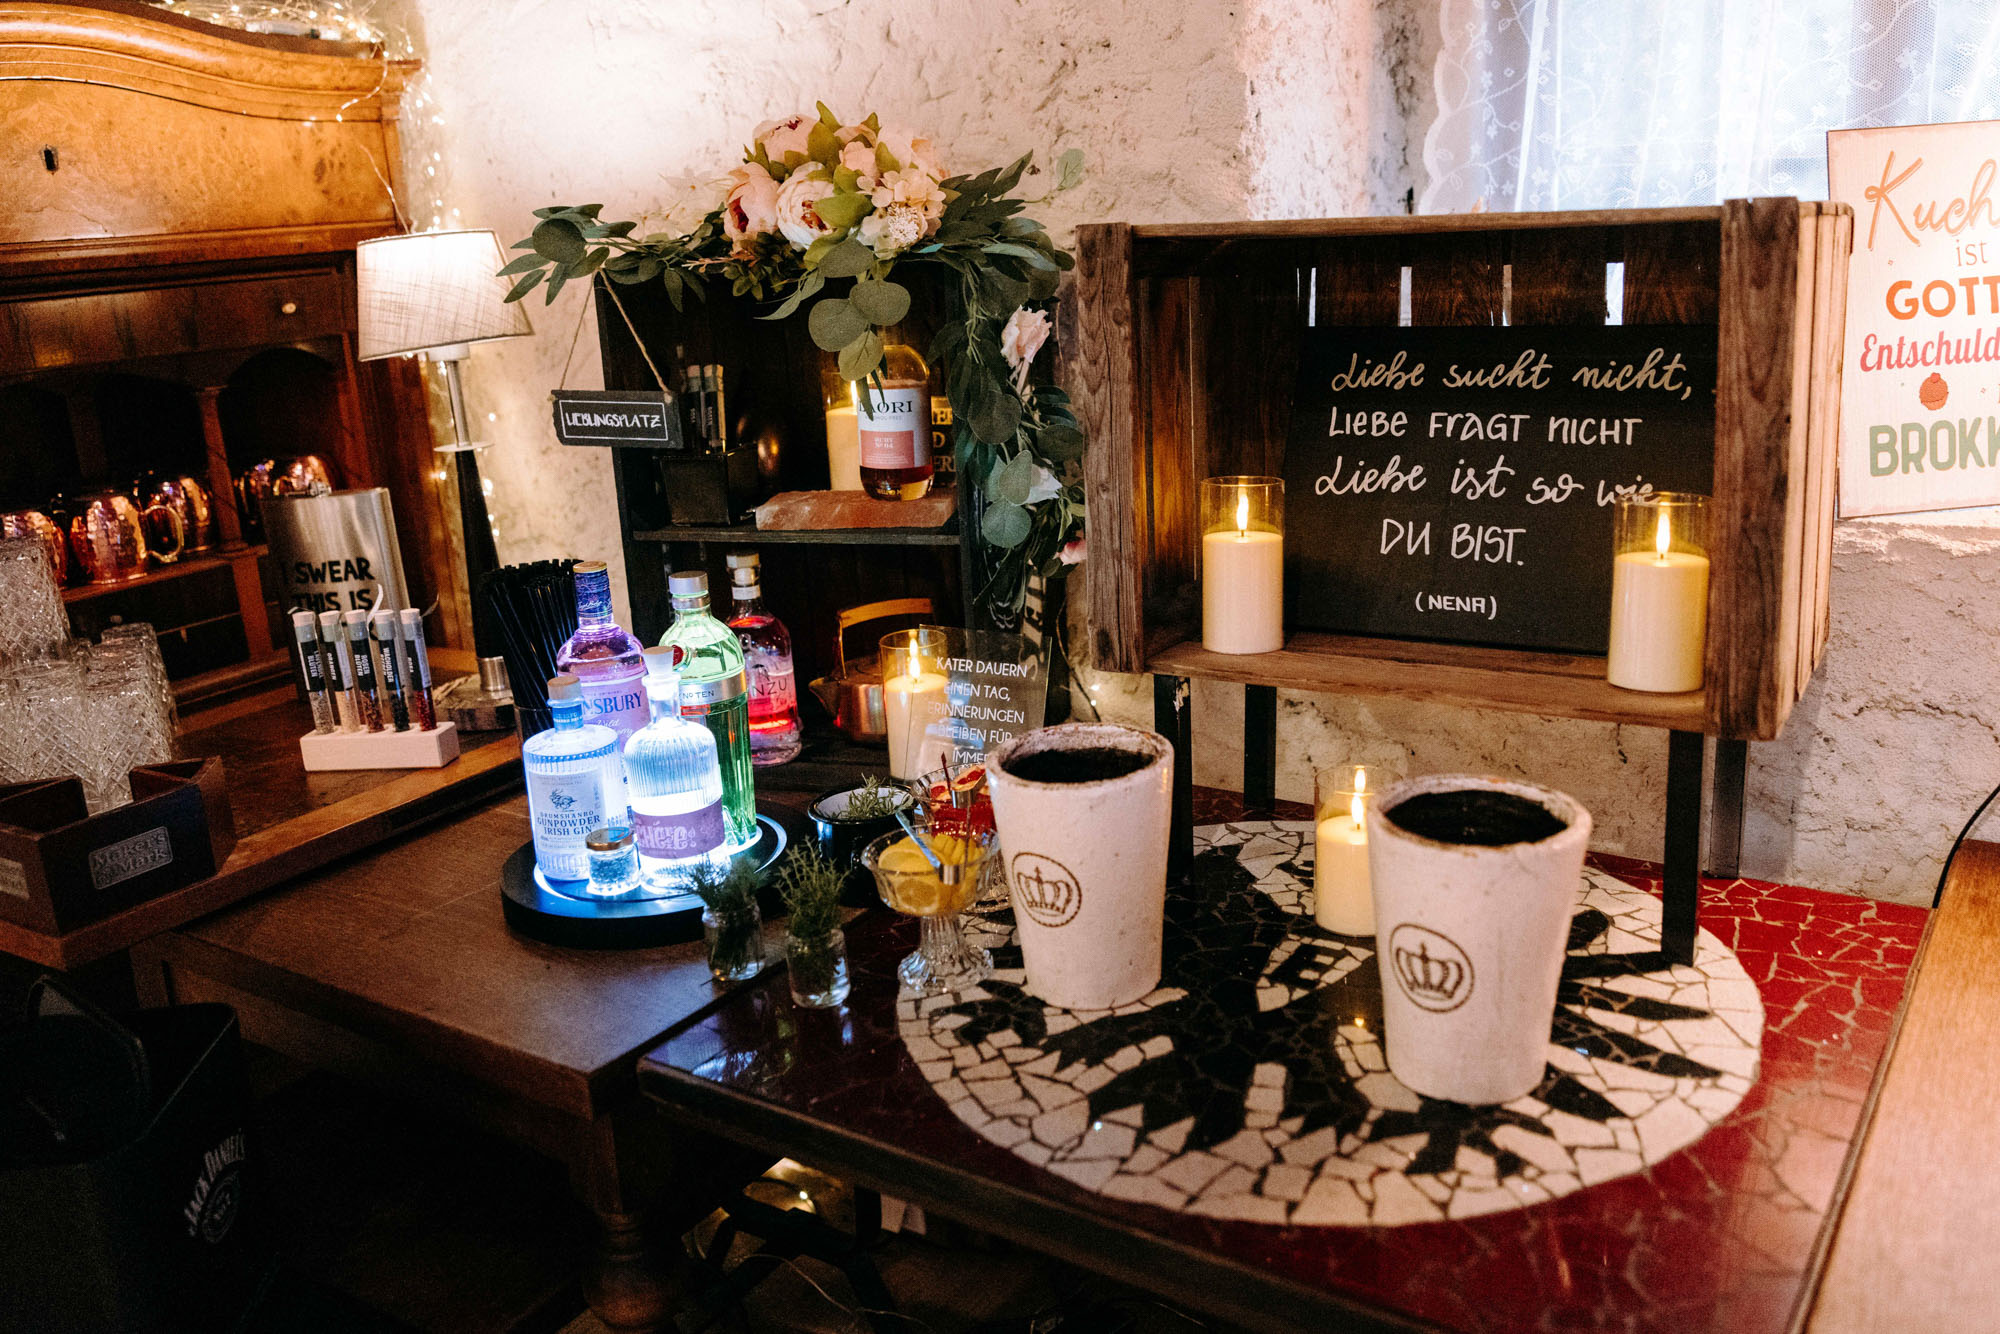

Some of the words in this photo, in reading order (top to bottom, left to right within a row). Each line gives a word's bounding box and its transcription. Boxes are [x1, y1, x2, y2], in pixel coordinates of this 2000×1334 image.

[1955, 239, 1989, 267] ist
[1885, 275, 2000, 320] GOTT
[1331, 350, 1425, 392] Liebe
[1442, 348, 1553, 390] sucht
[1571, 347, 1692, 401] nicht,
[565, 412, 662, 428] LIEBLINGSPLATZ
[1315, 454, 1427, 495] Liebe
[1450, 454, 1516, 501] ist
[1525, 473, 1585, 505] so
[1380, 518, 1431, 556] DU
[1450, 523, 1527, 566] BIST.
[294, 556, 375, 585] SWEAR
[290, 591, 342, 614] THIS
[348, 588, 374, 611] IS
[383, 647, 394, 683] WACHOLDER
[936, 656, 974, 673] KATER
[976, 660, 1028, 678] DAUERN
[695, 689, 715, 698] TEN
[943, 681, 981, 697] EINEN
[984, 685, 1011, 702] TAG,
[927, 700, 1025, 724] ERINNERUNGEN
[938, 724, 987, 742] BLEIBEN
[537, 814, 601, 828] GUNPOWDER
[544, 827, 570, 836] IRISH
